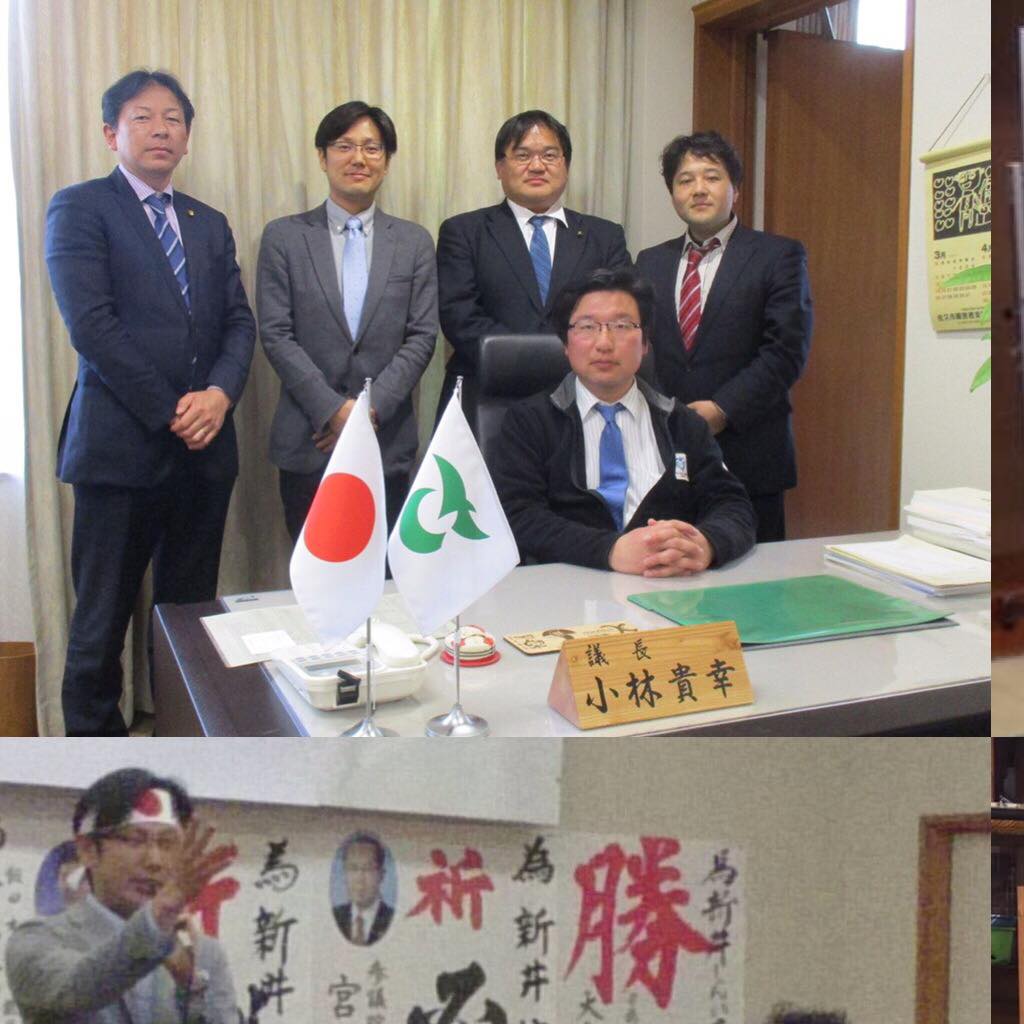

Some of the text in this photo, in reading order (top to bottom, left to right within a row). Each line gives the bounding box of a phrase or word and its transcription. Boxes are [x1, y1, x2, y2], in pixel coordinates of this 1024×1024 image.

[586, 639, 652, 668] 議長
[586, 658, 735, 714] 小林貴幸
[564, 835, 722, 1010] 勝
